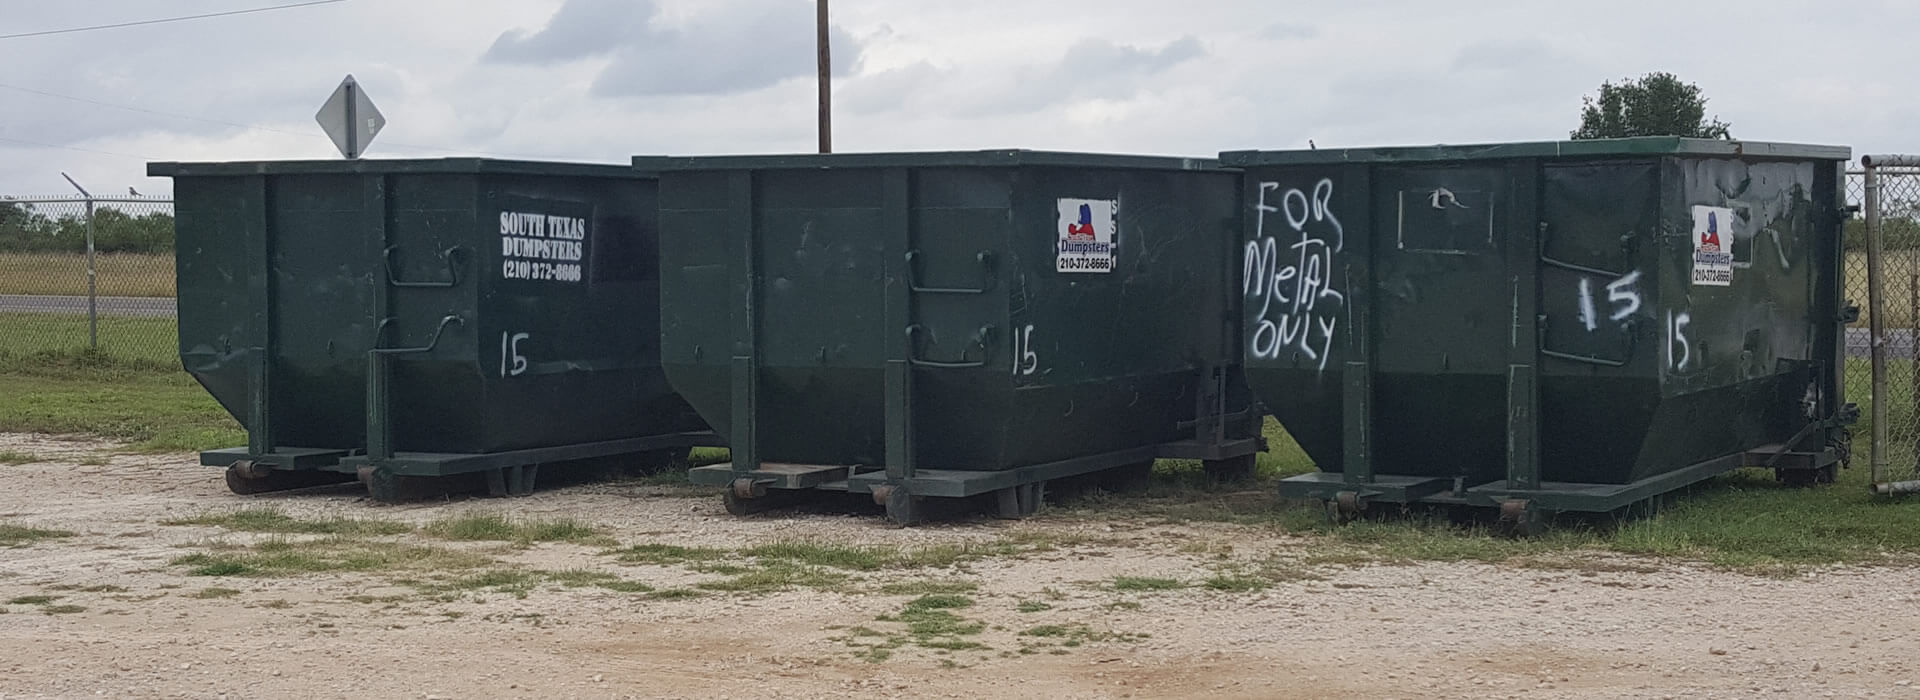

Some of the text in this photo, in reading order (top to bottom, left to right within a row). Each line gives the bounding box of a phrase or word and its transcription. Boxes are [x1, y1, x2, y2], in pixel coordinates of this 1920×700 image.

[500, 211, 585, 240] SOUTH TEXAS
[1256, 178, 1344, 254] FOR
[502, 237, 582, 261] DUMPSTERS
[1061, 239, 1110, 257] Dumpsters
[1696, 248, 1730, 268] Dumpsters
[503, 260, 581, 282] (210) 372-8666
[1060, 257, 1110, 270] 210-372-8666
[1695, 269, 1730, 283] 210-372-8666
[1578, 270, 1641, 332] 15
[501, 330, 529, 378] 15
[1012, 324, 1038, 376] 15
[1253, 312, 1336, 371] ONLY
[1667, 309, 1690, 371] 15
